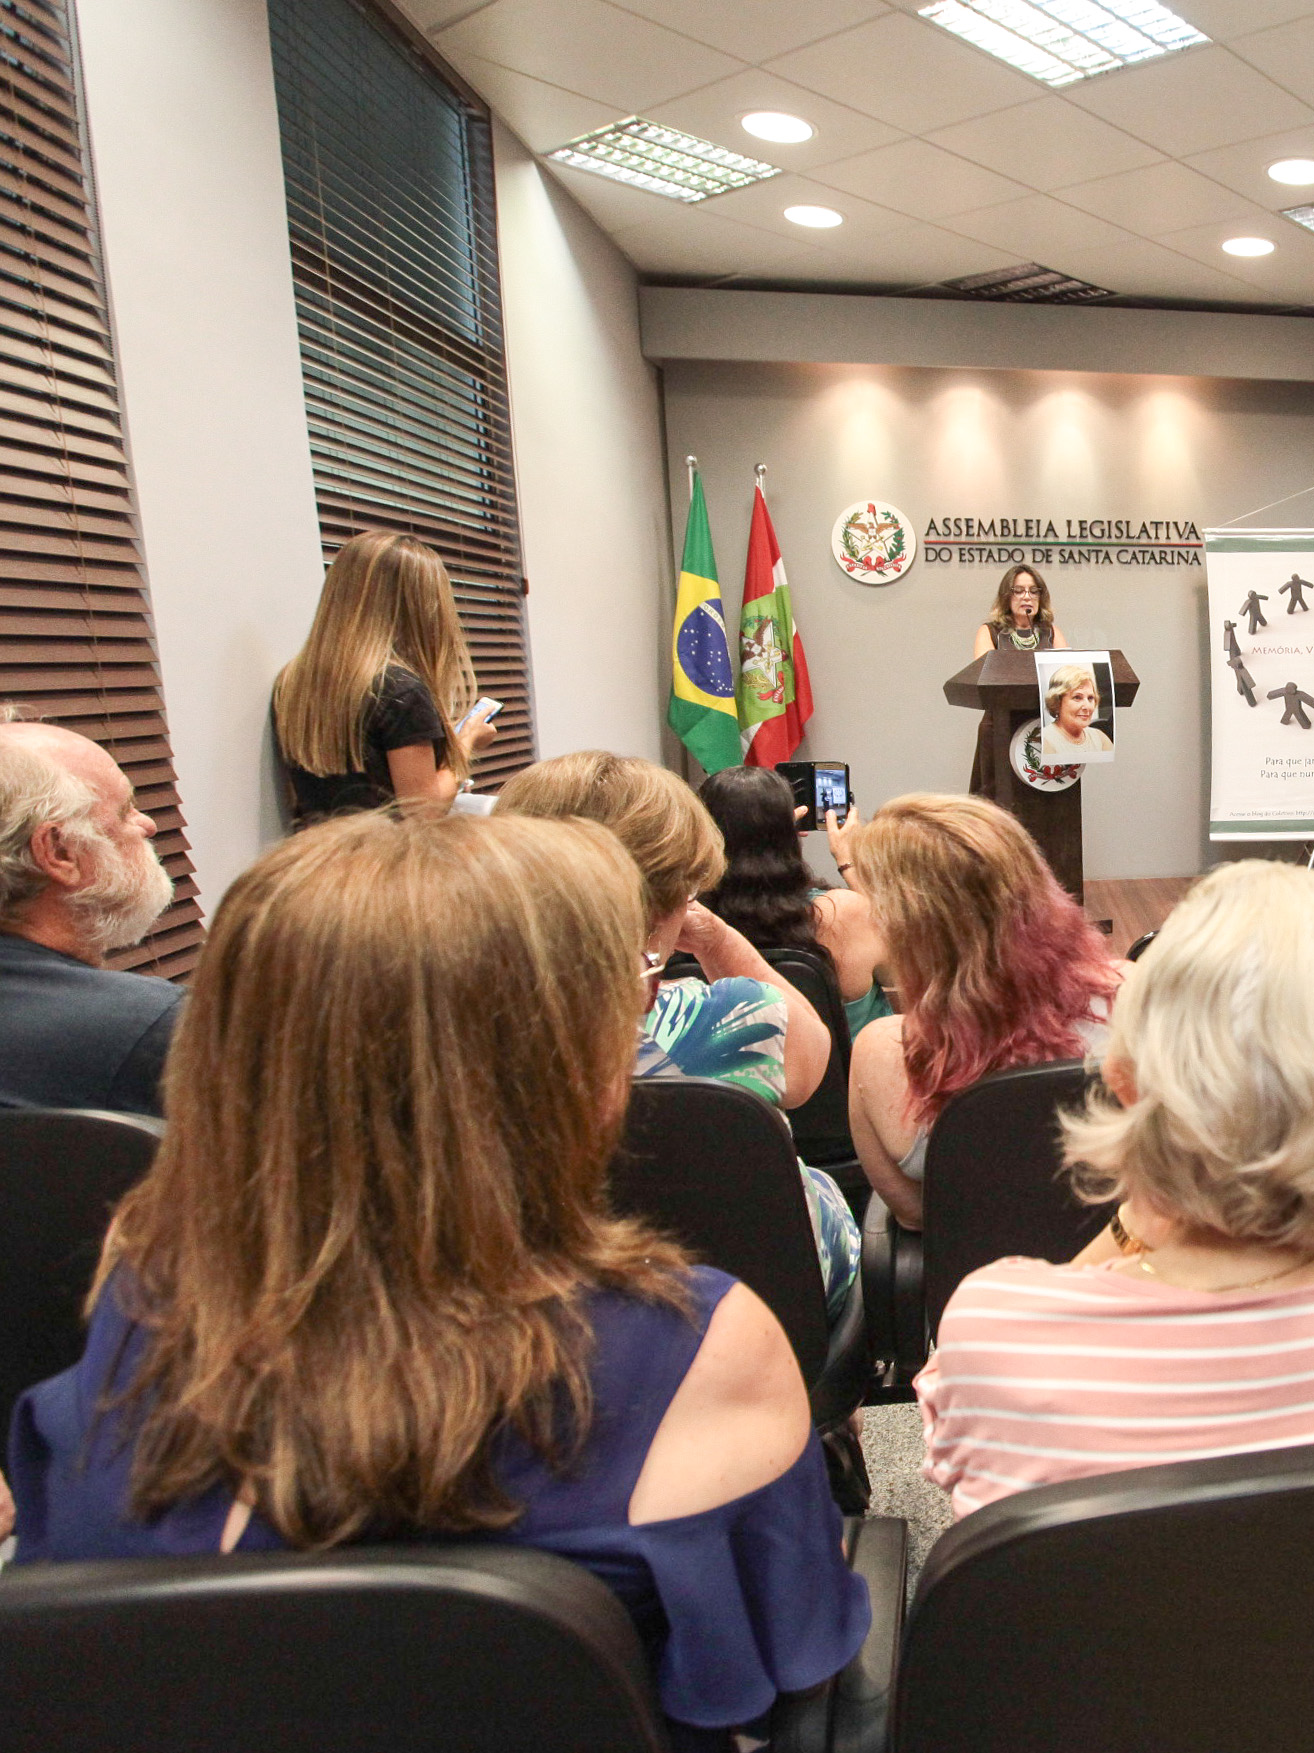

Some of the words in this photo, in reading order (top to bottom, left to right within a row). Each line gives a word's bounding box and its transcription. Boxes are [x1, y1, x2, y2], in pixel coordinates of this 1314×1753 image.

[924, 517, 1059, 538] ASSEMBLEIA
[1066, 519, 1201, 540] LEGISLATIVA
[924, 547, 953, 563] DO
[958, 547, 1025, 564] ESTADO
[1032, 548, 1053, 564] DE
[1059, 549, 1113, 565] SANTA
[1116, 549, 1202, 566] CATARINA
[1265, 757, 1283, 766] Para
[1286, 759, 1302, 768] que
[1260, 770, 1279, 779] Para
[1281, 771, 1297, 780] que
